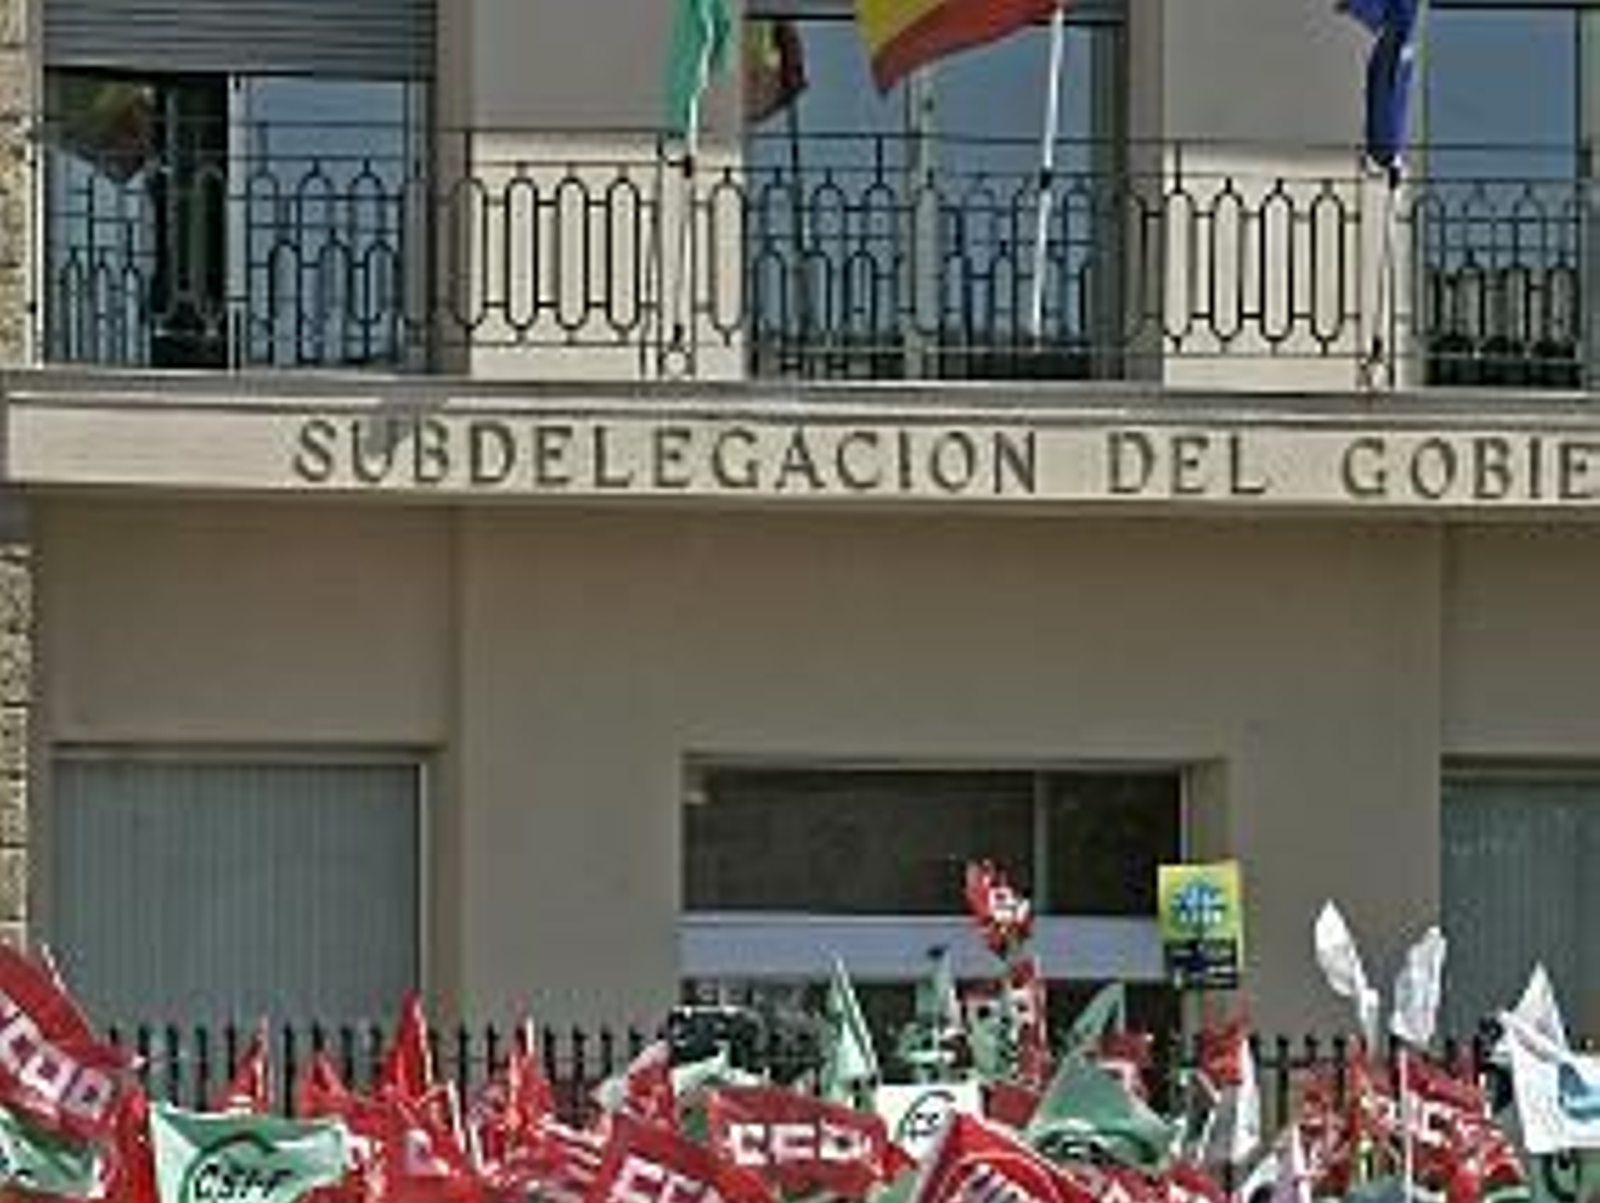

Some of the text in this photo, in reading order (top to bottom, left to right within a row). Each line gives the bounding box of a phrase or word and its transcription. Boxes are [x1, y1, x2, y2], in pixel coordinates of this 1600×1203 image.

[294, 418, 1600, 500] SUBDELEGACION DEL GOBIE
